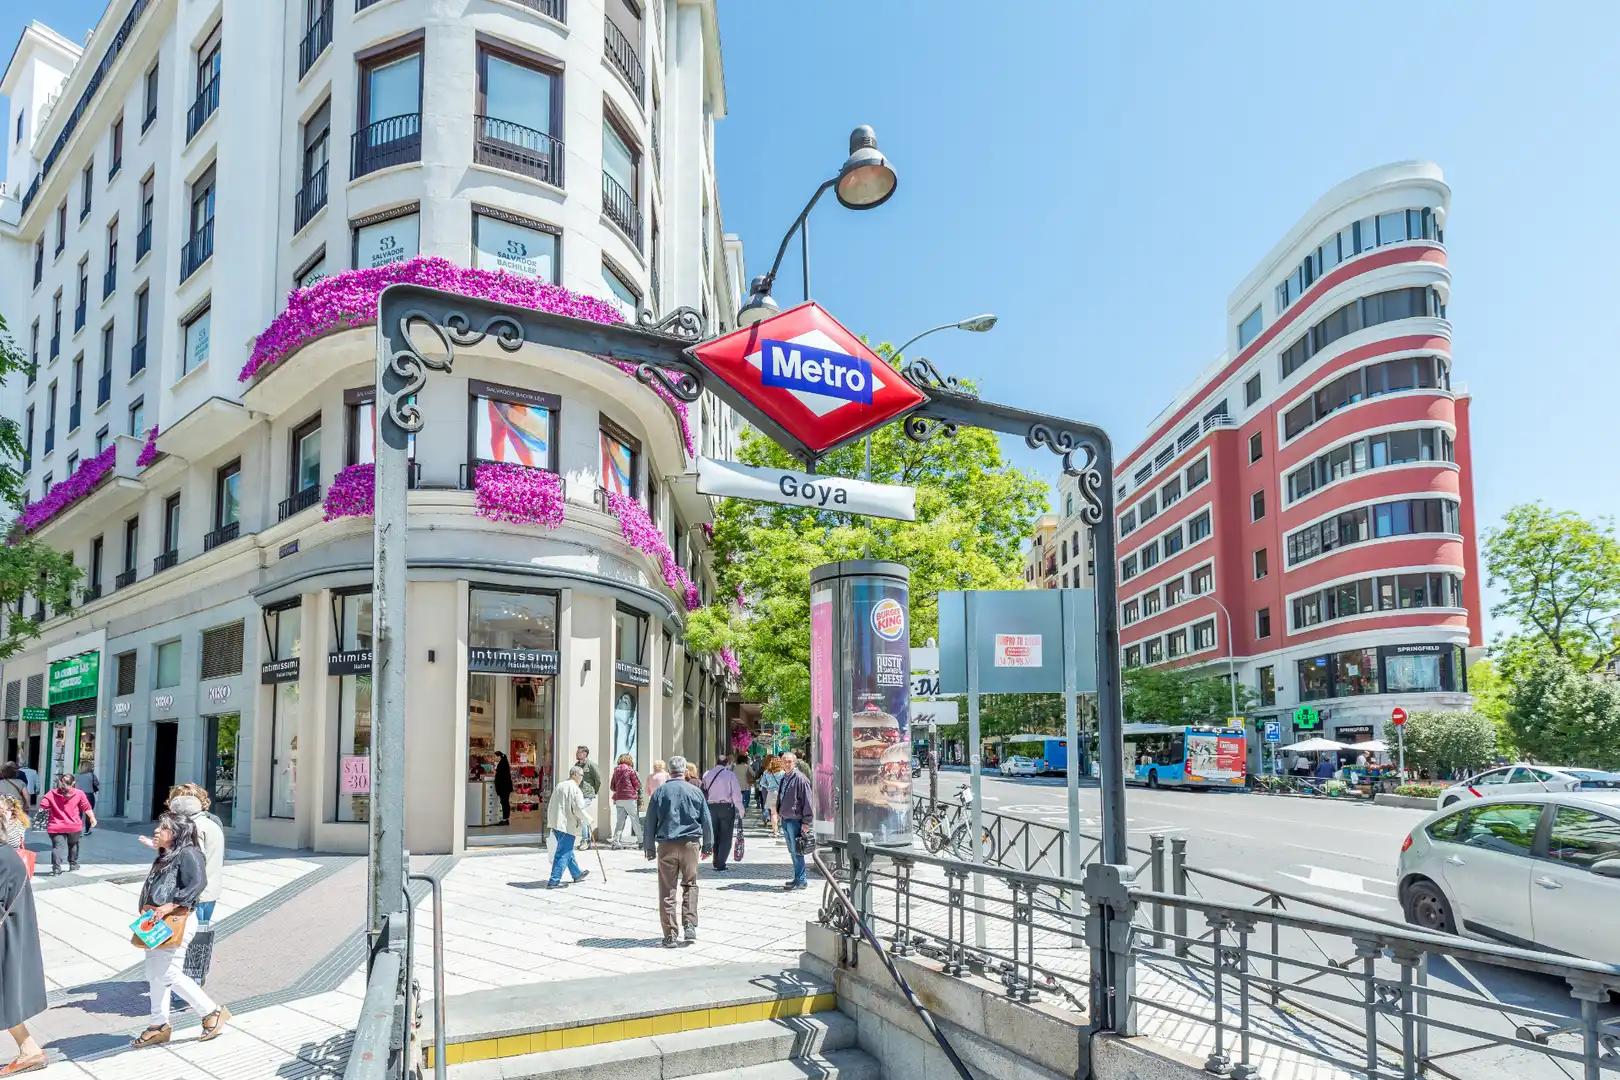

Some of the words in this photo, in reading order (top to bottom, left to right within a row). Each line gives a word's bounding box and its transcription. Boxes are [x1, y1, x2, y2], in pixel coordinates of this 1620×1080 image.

[371, 247, 404, 261] SALVADOR
[497, 251, 537, 267] SALVADOR
[497, 259, 537, 274] BACHILLER
[772, 346, 865, 392] Metro
[486, 386, 515, 396] SALVADOR
[779, 475, 848, 506] Goya
[876, 607, 900, 621] BURGER
[877, 615, 902, 631] KING
[471, 650, 558, 662] intimissimi
[1397, 645, 1440, 653] SPRINGFIELD
[262, 660, 298, 673] intimissimi
[877, 673, 904, 685] CHEESE
[208, 685, 231, 700] KIKO
[114, 701, 131, 714] KIKO
[155, 694, 174, 708] KIKO
[345, 763, 369, 773] SAL
